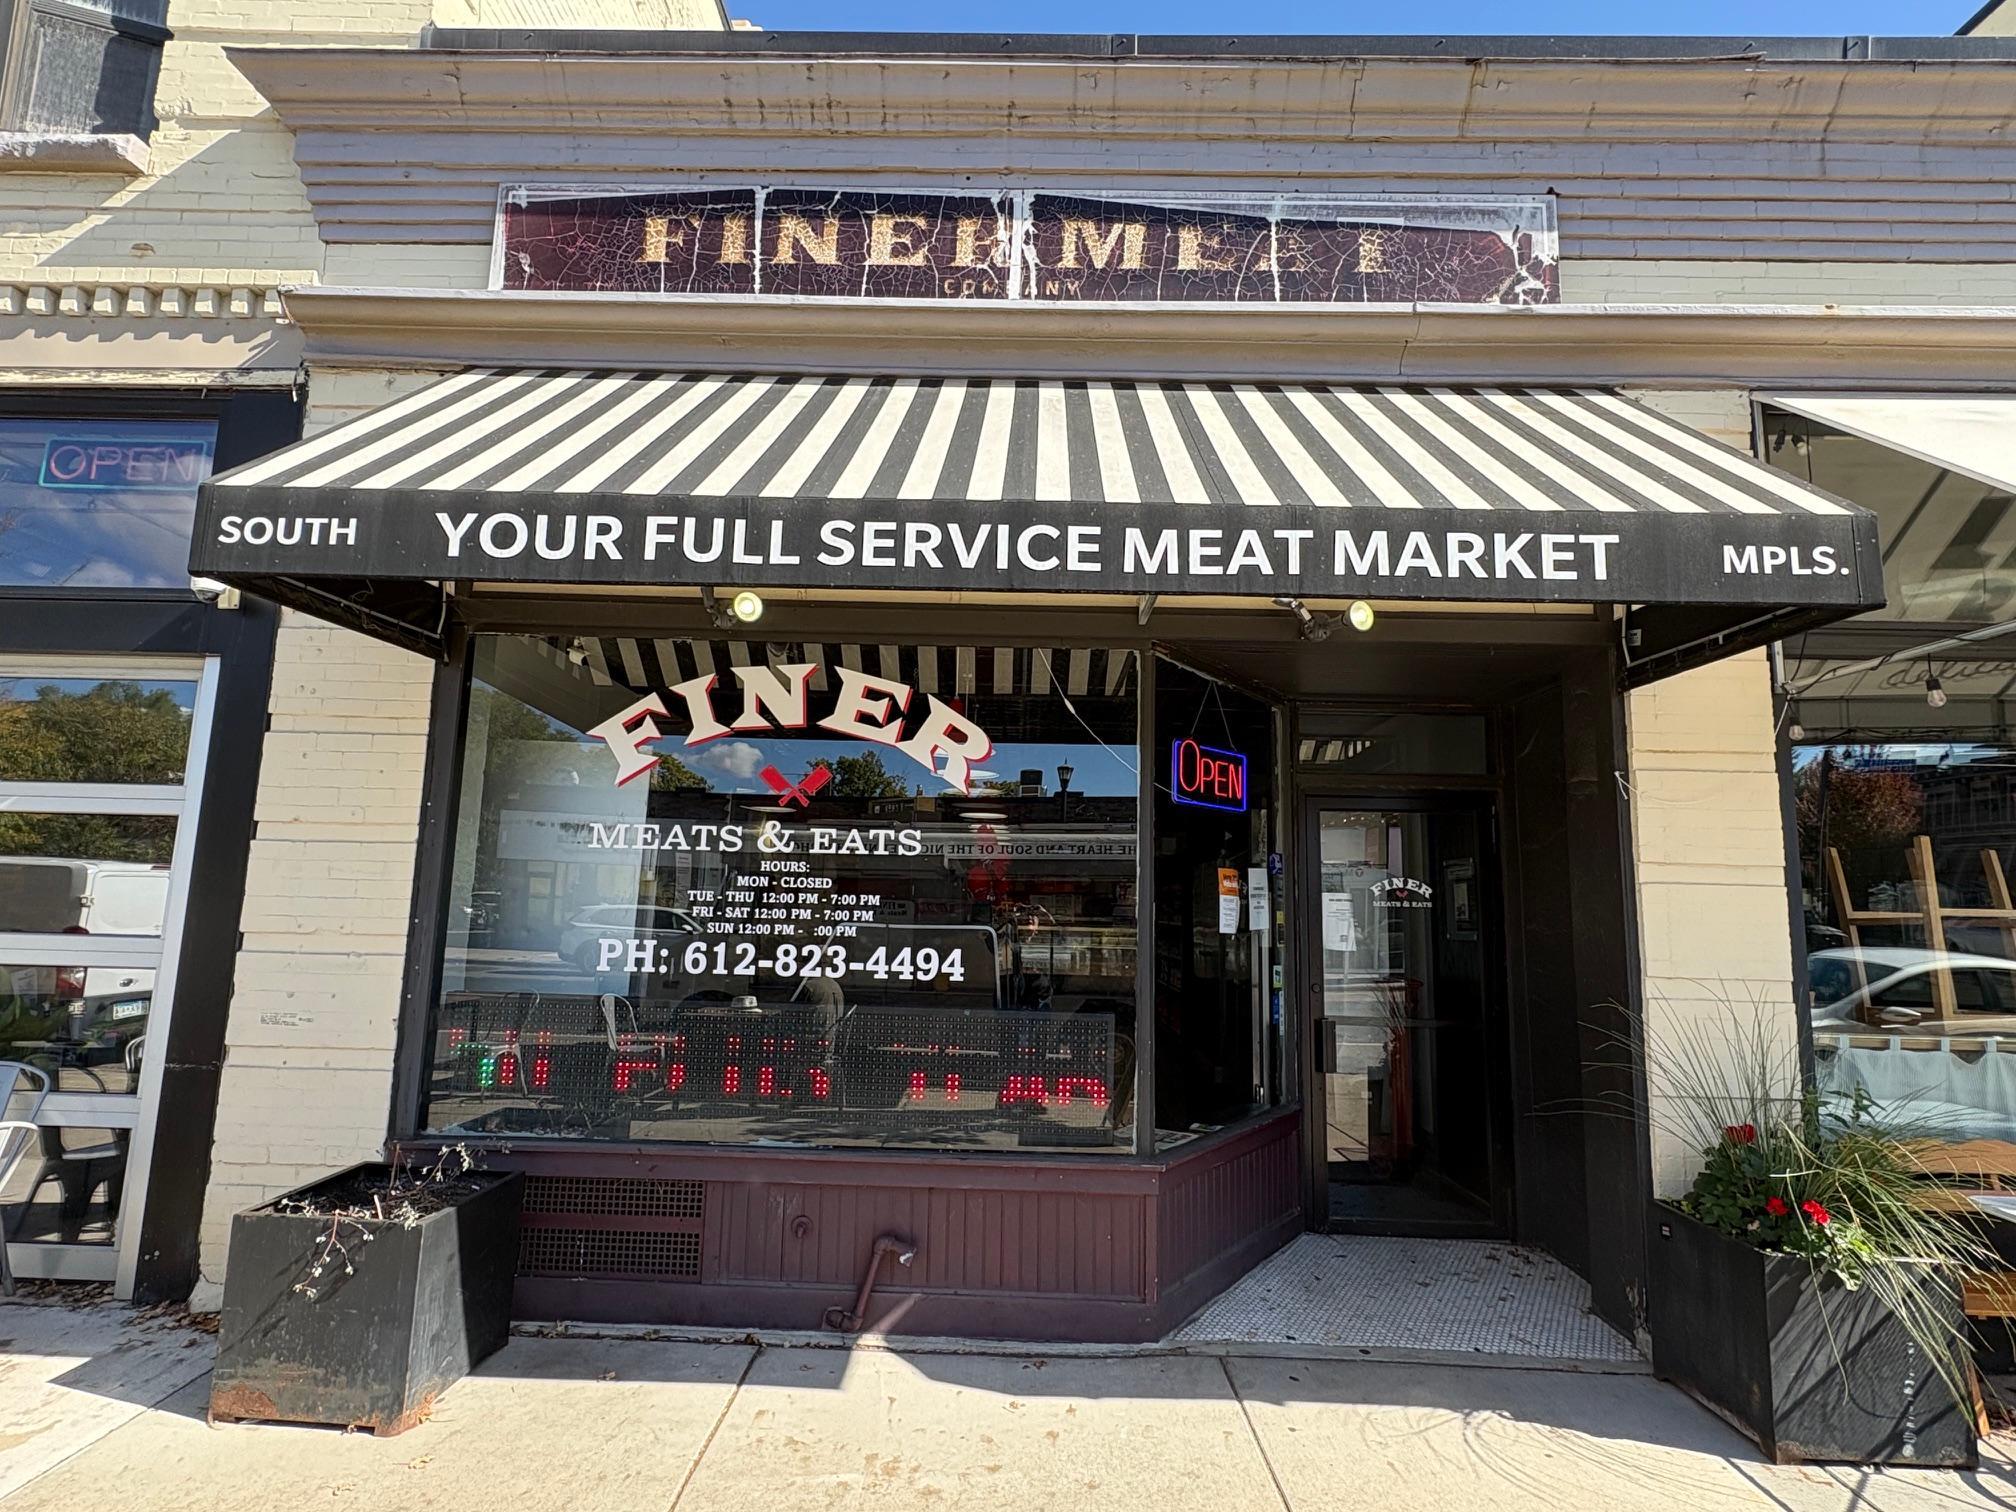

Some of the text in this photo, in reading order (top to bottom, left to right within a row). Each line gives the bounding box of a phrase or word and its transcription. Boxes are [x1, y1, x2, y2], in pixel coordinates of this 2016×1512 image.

[944, 279, 1080, 297] COMANY
[50, 445, 195, 481] OPEN
[217, 512, 1850, 581] SOUTH YOUR FULL SERVICE MEAT MARKET MPLS.
[586, 663, 993, 796] FINER
[587, 820, 922, 856] MEATS & EATS
[760, 861, 810, 873] HOURS:
[736, 876, 768, 888] MON
[780, 877, 832, 889] CLOSED
[1369, 877, 1433, 899] FINER
[687, 890, 714, 901] TUE
[725, 891, 754, 903] THU
[762, 892, 795, 903] 12:00
[798, 893, 819, 905] PM
[830, 894, 856, 906] 7:00
[858, 894, 881, 906] PM
[1372, 900, 1401, 908] MEATS
[692, 906, 714, 918] FRI
[725, 907, 750, 919] SAT
[754, 908, 787, 920] 12:00
[791, 909, 812, 920] PM
[824, 910, 850, 921] 7:00
[852, 910, 874, 922] PM
[707, 922, 734, 934] SUN
[738, 924, 771, 935] 12:00
[774, 925, 795, 936] PM
[836, 926, 857, 938] PM
[596, 938, 965, 982] PH: 612-823-4494
